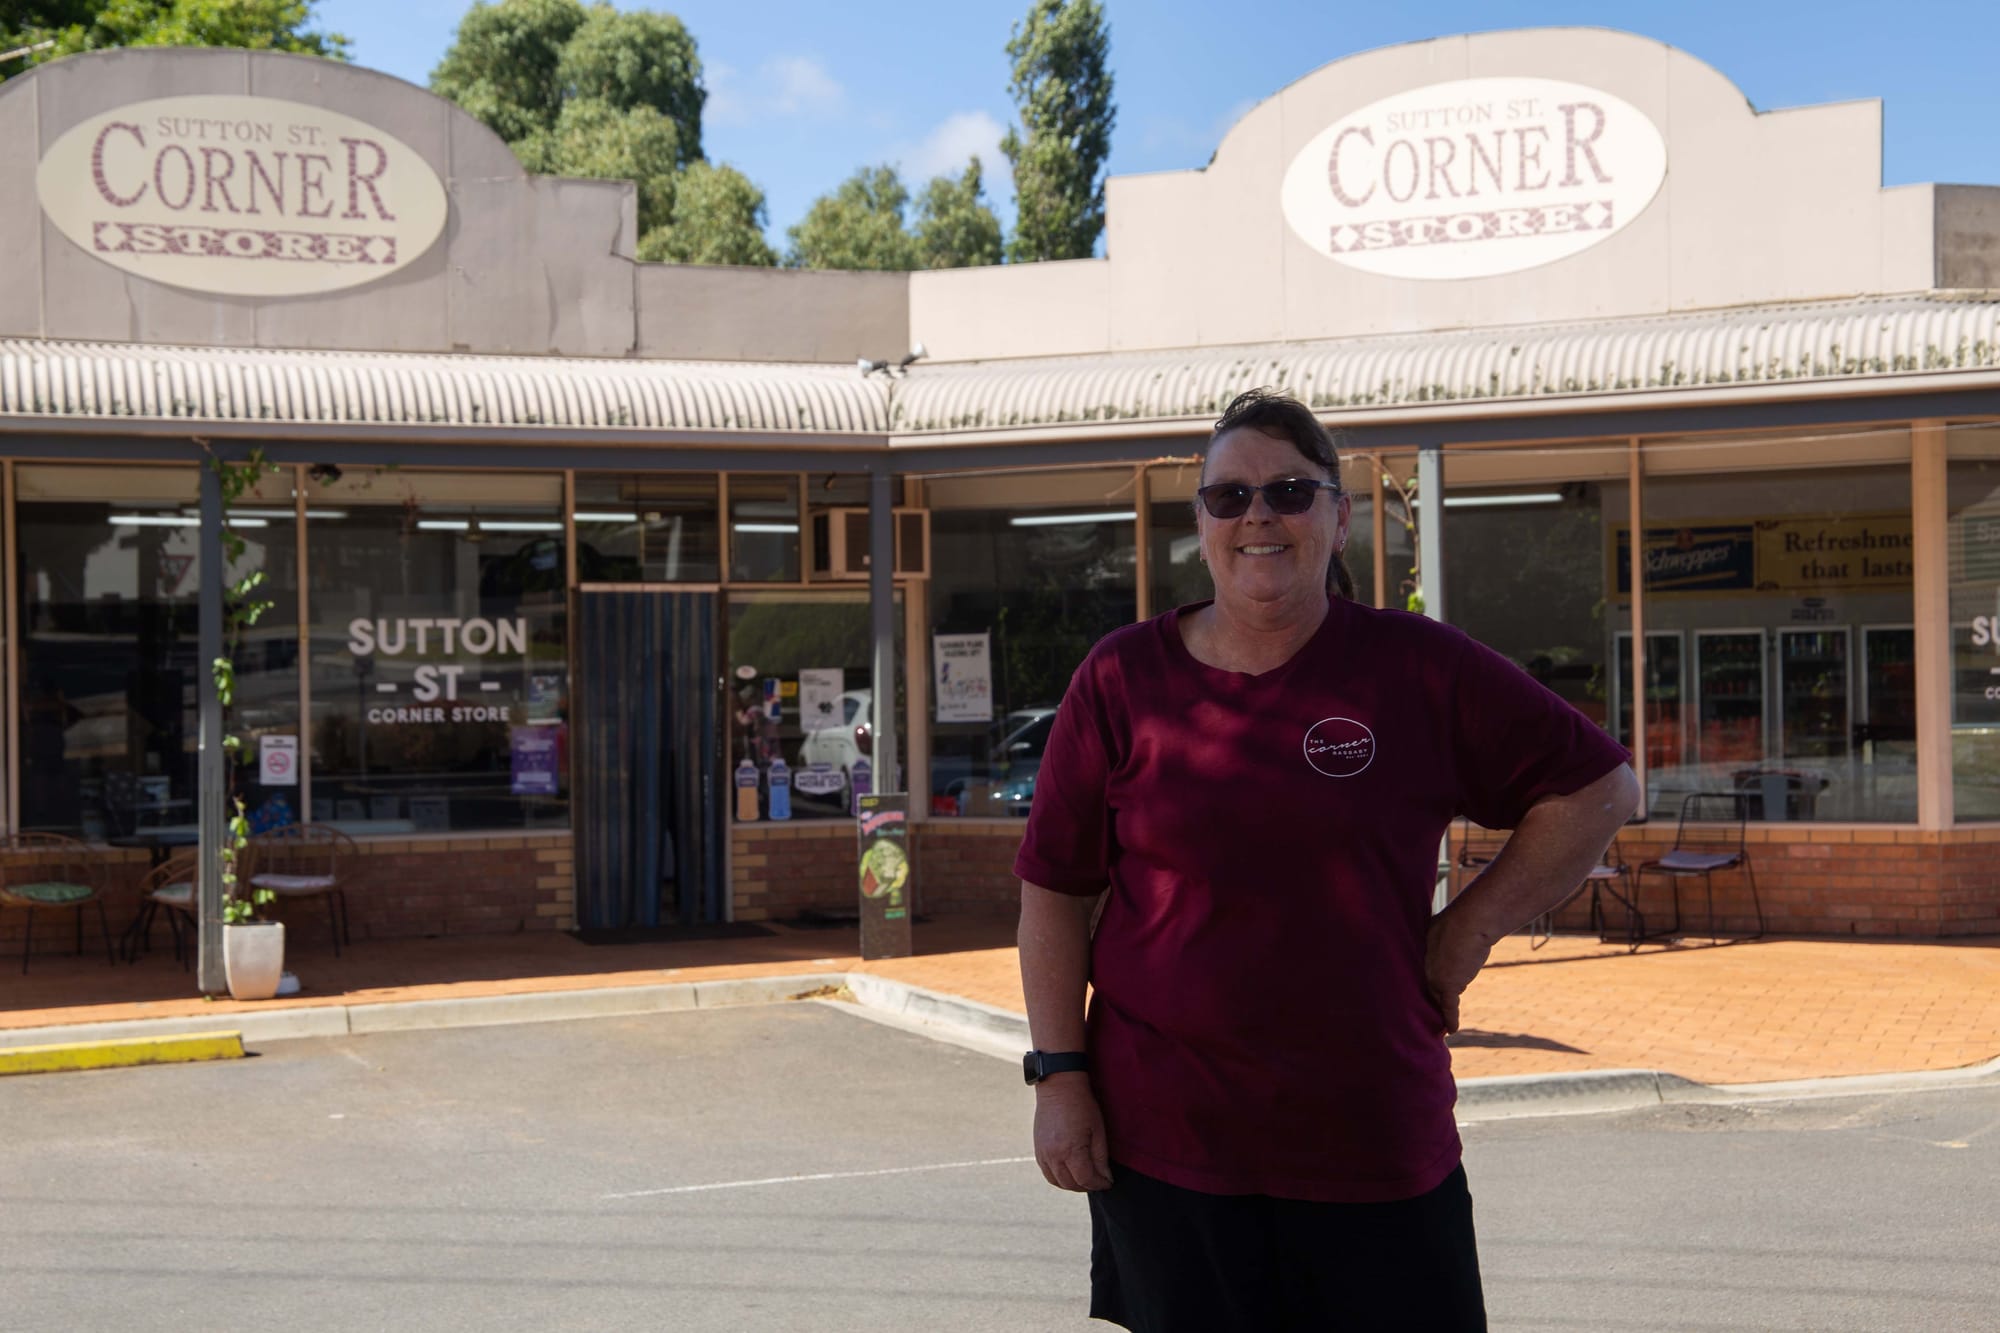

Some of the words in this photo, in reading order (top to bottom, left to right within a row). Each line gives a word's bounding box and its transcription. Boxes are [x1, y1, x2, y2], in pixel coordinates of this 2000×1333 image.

[157, 116, 273, 143] SUTTON
[288, 126, 327, 146] ST.
[1386, 104, 1494, 134] SUTTON
[1507, 98, 1545, 120] ST.
[91, 121, 396, 222] CORNER
[1328, 101, 1614, 208] CORNER
[130, 225, 363, 260] STORE
[1364, 203, 1578, 249] STORE
[1801, 559, 1849, 580] that
[348, 617, 527, 656] SUTTON
[413, 664, 464, 702] ST
[367, 708, 445, 725] CORNER
[451, 706, 510, 723] STORE
